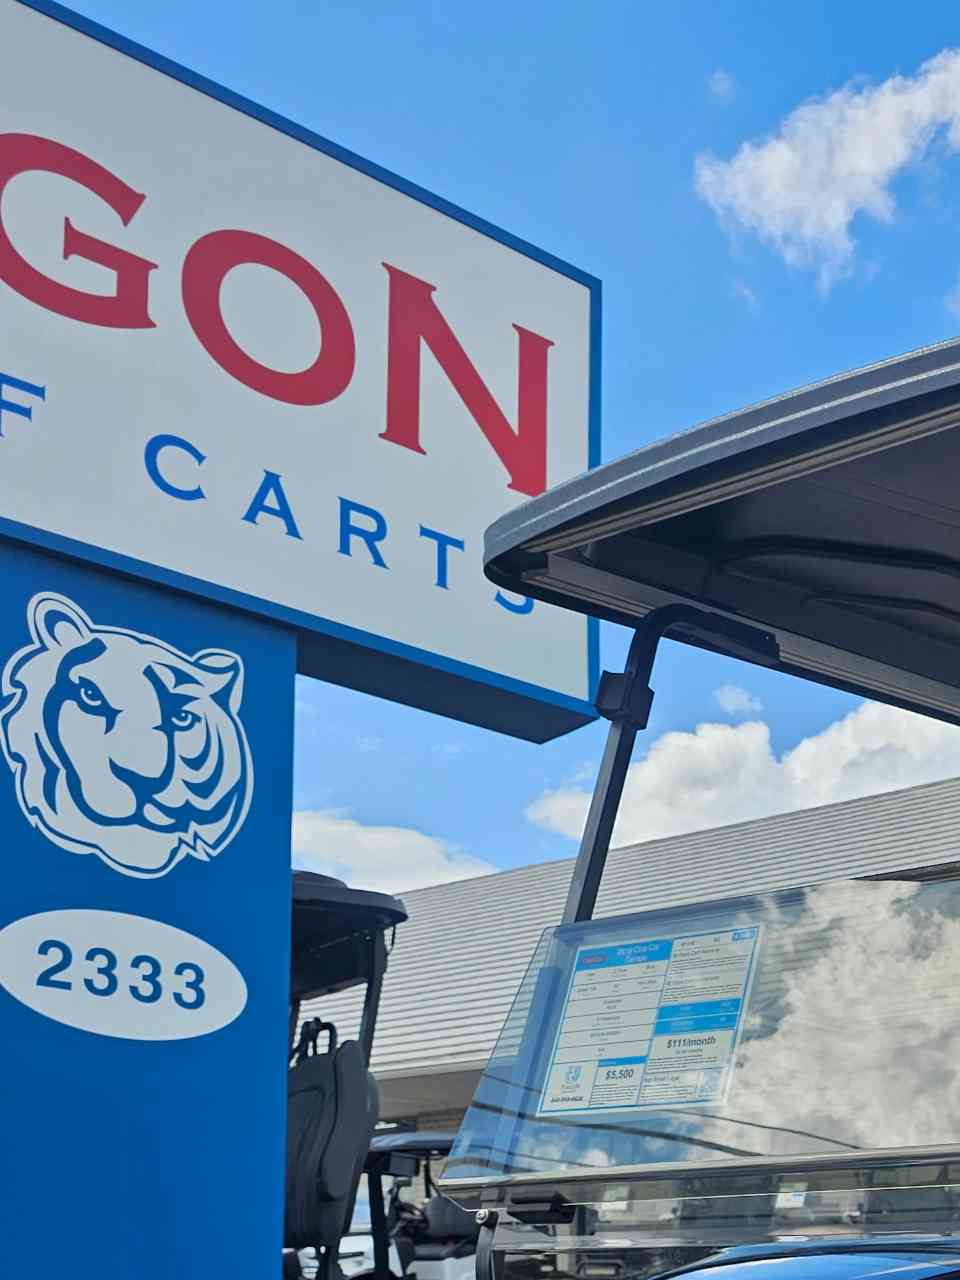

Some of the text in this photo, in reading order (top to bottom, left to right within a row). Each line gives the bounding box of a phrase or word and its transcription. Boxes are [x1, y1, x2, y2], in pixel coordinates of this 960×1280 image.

[0, 132, 555, 498] GON
[36, 939, 206, 1010] 2333
[606, 1069, 634, 1080] $5,500
